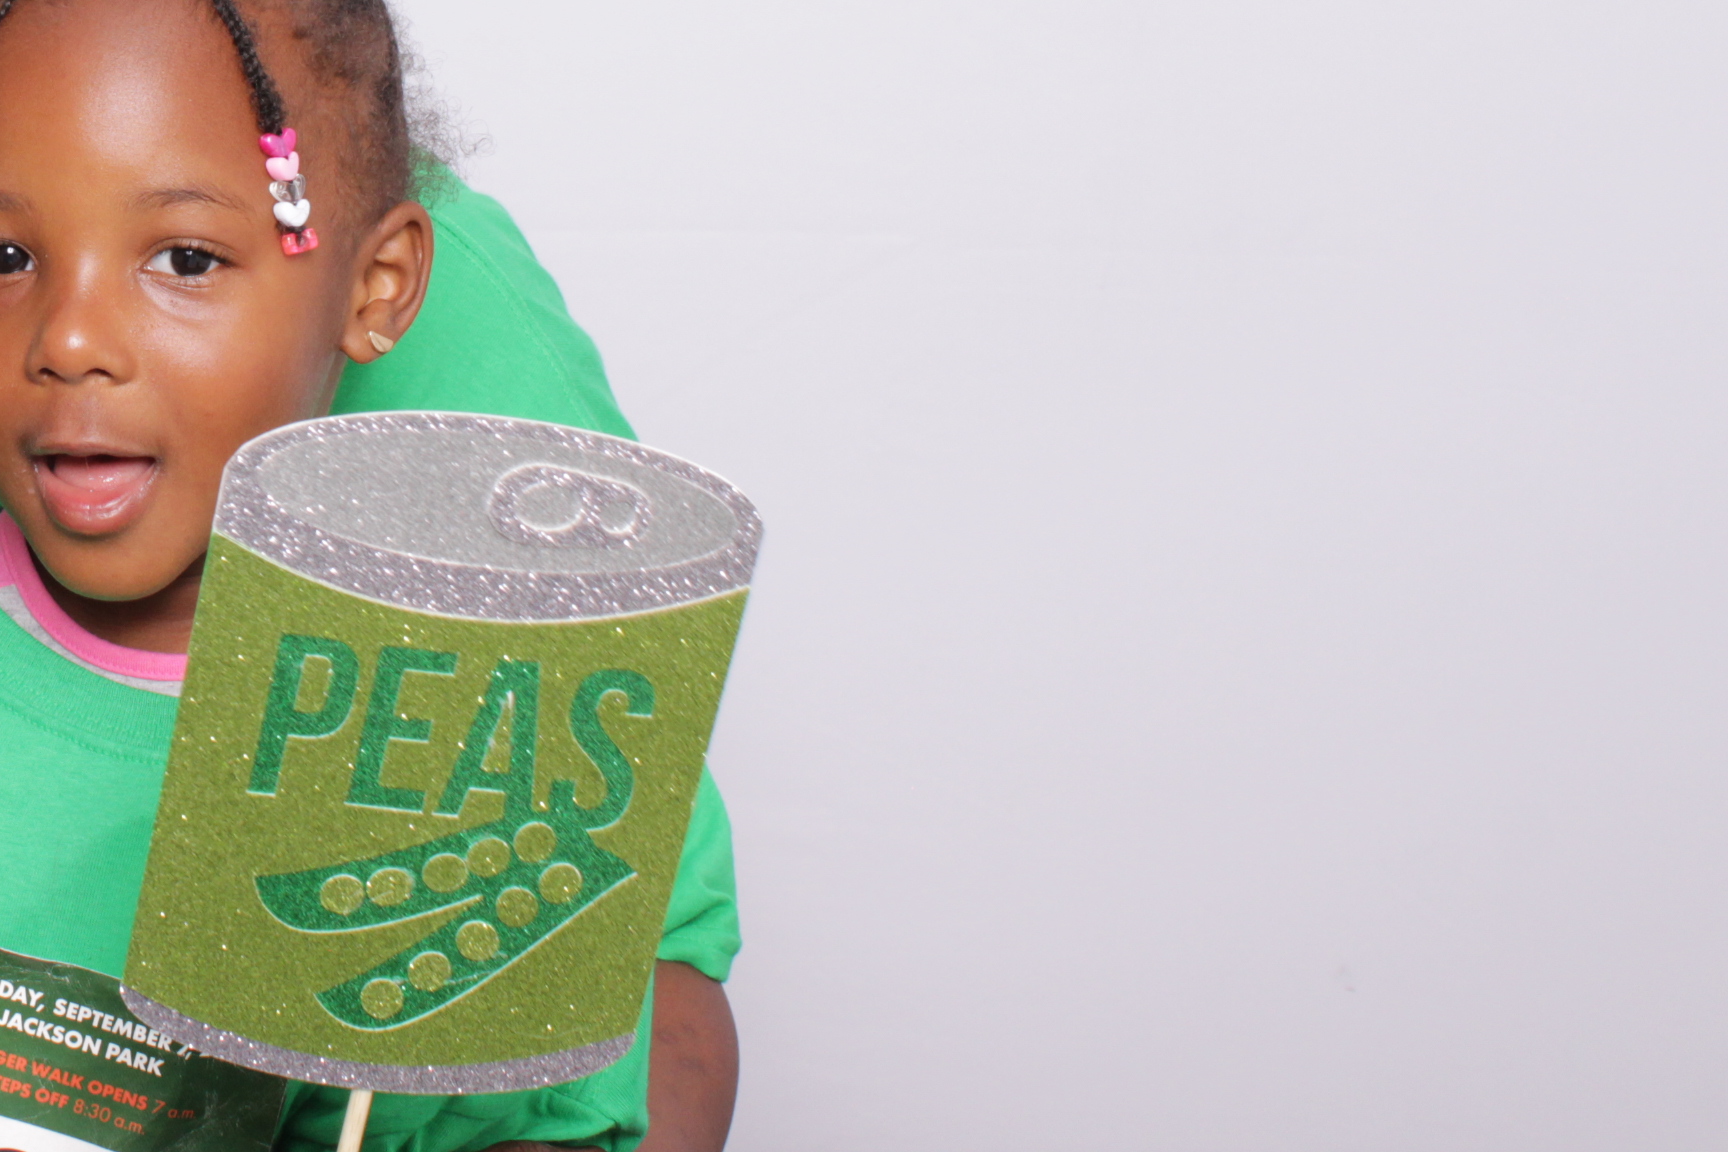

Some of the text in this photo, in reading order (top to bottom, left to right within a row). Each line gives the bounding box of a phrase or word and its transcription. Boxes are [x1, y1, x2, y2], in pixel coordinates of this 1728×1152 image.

[246, 634, 657, 833] PEAS
[52, 998, 173, 1052] SEPTEMBER
[105, 1042, 165, 1077] PARK
[31, 1060, 83, 1090] WALK
[87, 1080, 148, 1111] OPENS
[151, 1100, 167, 1114] 7
[34, 1087, 70, 1109] OFF
[72, 1098, 112, 1124] 8:30
[113, 1115, 146, 1135] a.m.
